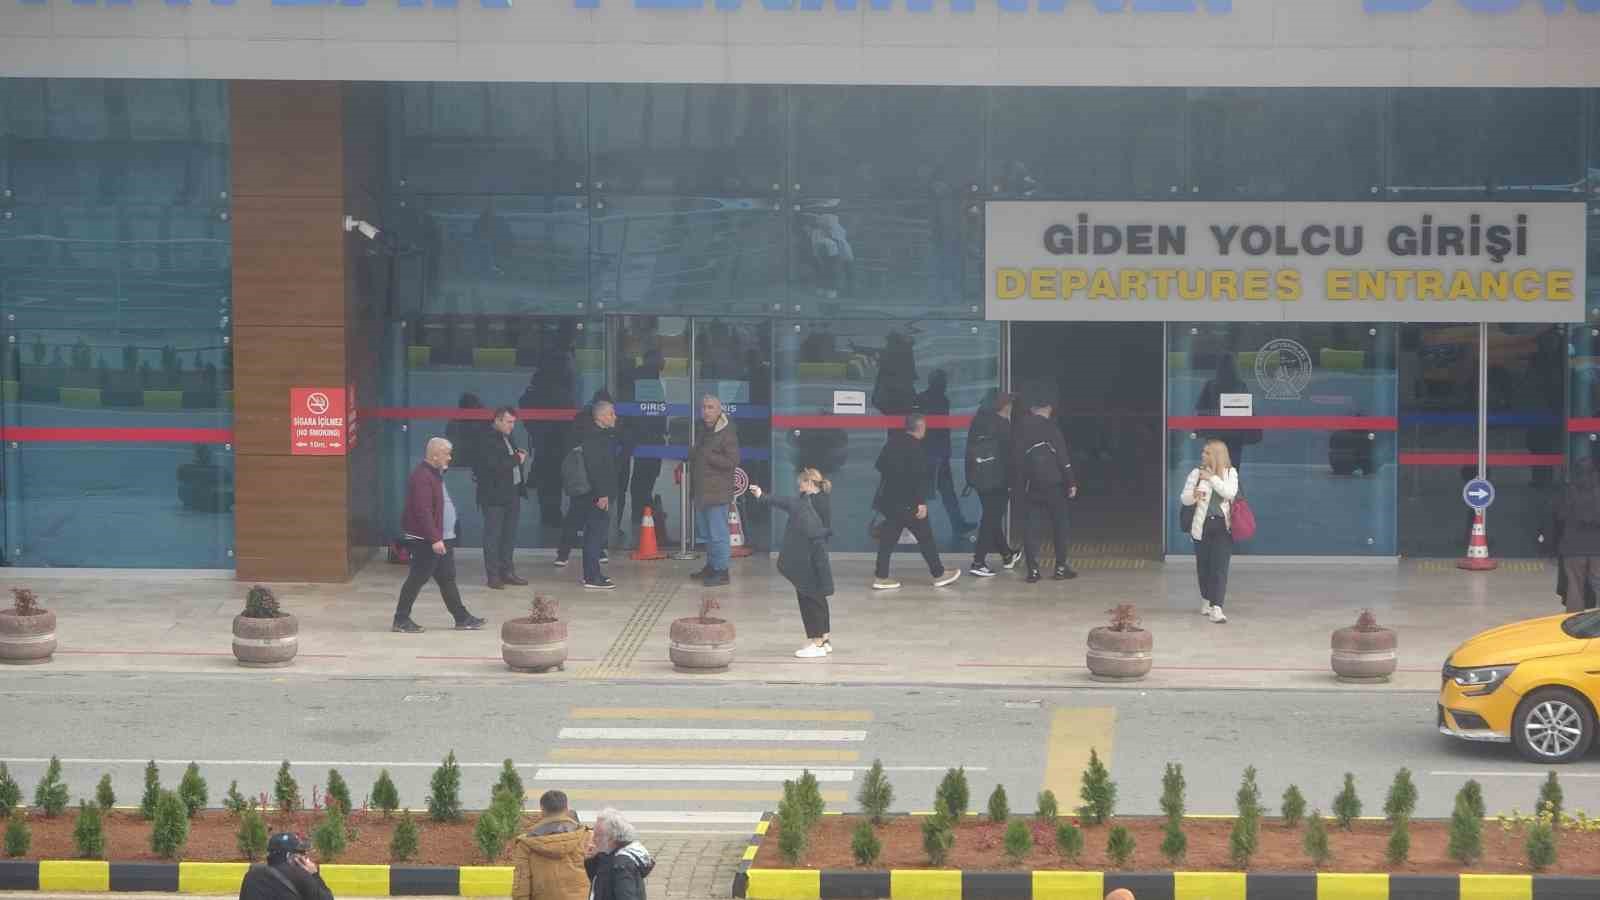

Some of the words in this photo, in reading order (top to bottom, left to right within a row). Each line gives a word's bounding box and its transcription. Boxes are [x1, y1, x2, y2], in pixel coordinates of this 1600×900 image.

[1043, 212, 1186, 256] GİDEN
[1209, 224, 1364, 257] YOLCU
[1387, 213, 1529, 264] GİRİŞİ
[996, 267, 1301, 301] DEPARTURES
[1326, 268, 1575, 301] ENTRANCE
